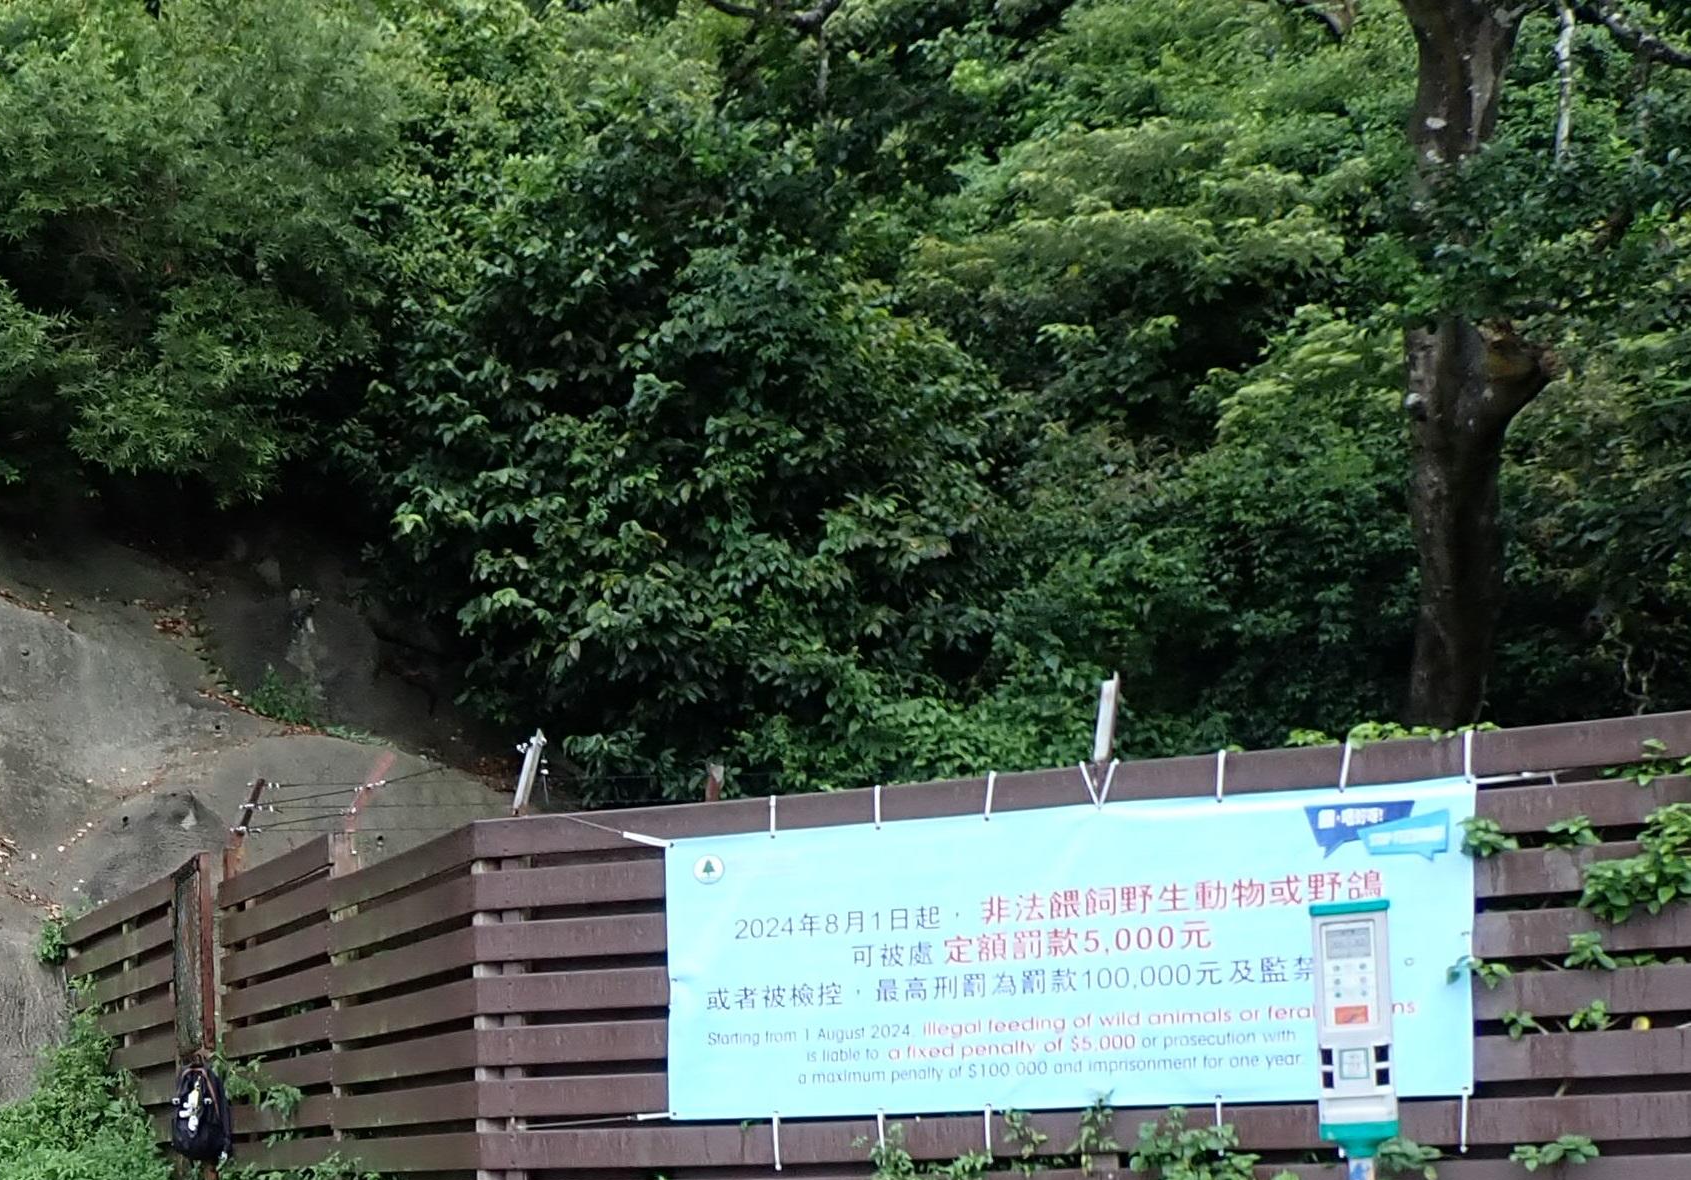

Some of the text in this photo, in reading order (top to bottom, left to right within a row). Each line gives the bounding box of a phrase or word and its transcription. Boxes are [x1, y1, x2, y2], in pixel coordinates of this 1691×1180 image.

[707, 1031, 760, 1046] Starting
[765, 1030, 797, 1044] from
[817, 1026, 865, 1044] August
[923, 1019, 982, 1038] illegal
[988, 1015, 1066, 1034] feeding
[1073, 1012, 1091, 1028] of
[1099, 1011, 1141, 1027] wild
[1147, 1007, 1232, 1025] animals
[1239, 1008, 1260, 1021] or
[1267, 1002, 1315, 1021] feral
[806, 1051, 817, 1063] is
[822, 1048, 860, 1062] liable
[865, 1047, 880, 1061] to
[888, 1048, 900, 1061] a
[906, 1043, 955, 1061] fixed
[961, 1038, 1036, 1060] penalty
[1044, 1036, 1063, 1053] of
[1141, 1036, 1158, 1049] or
[1163, 1032, 1256, 1050] prosecution
[1262, 1029, 1297, 1043] with
[798, 1073, 807, 1085] a
[812, 1068, 886, 1085] maximum
[891, 1065, 943, 1084] penalty
[949, 1064, 962, 1080] of
[968, 1060, 1048, 1079] $100000
[1054, 1059, 1083, 1074] and
[1088, 1055, 1198, 1076] imprisonment
[1203, 1055, 1224, 1070] for
[1229, 1055, 1260, 1069] one
